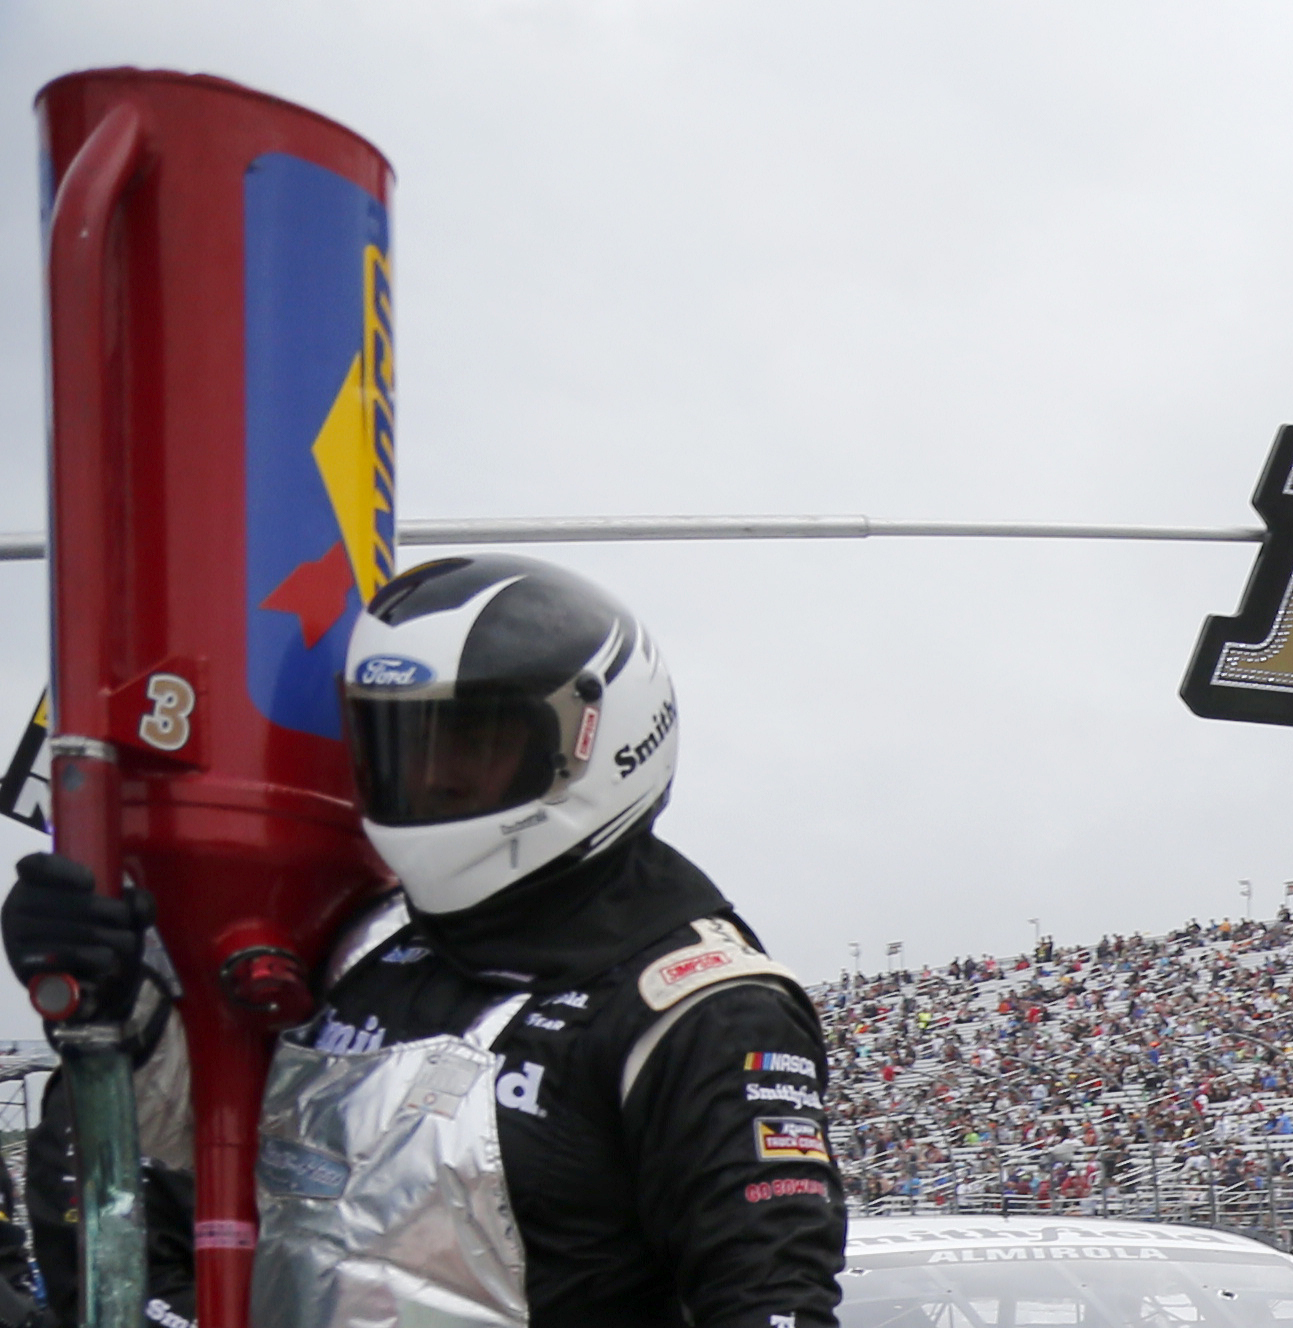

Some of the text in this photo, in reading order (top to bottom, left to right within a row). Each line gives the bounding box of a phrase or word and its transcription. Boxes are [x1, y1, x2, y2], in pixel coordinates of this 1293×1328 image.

[361, 657, 417, 687] Ford
[139, 673, 196, 750] 3
[849, 1225, 1230, 1246] mithfield
[926, 1247, 1169, 1263] ALMIROLA
